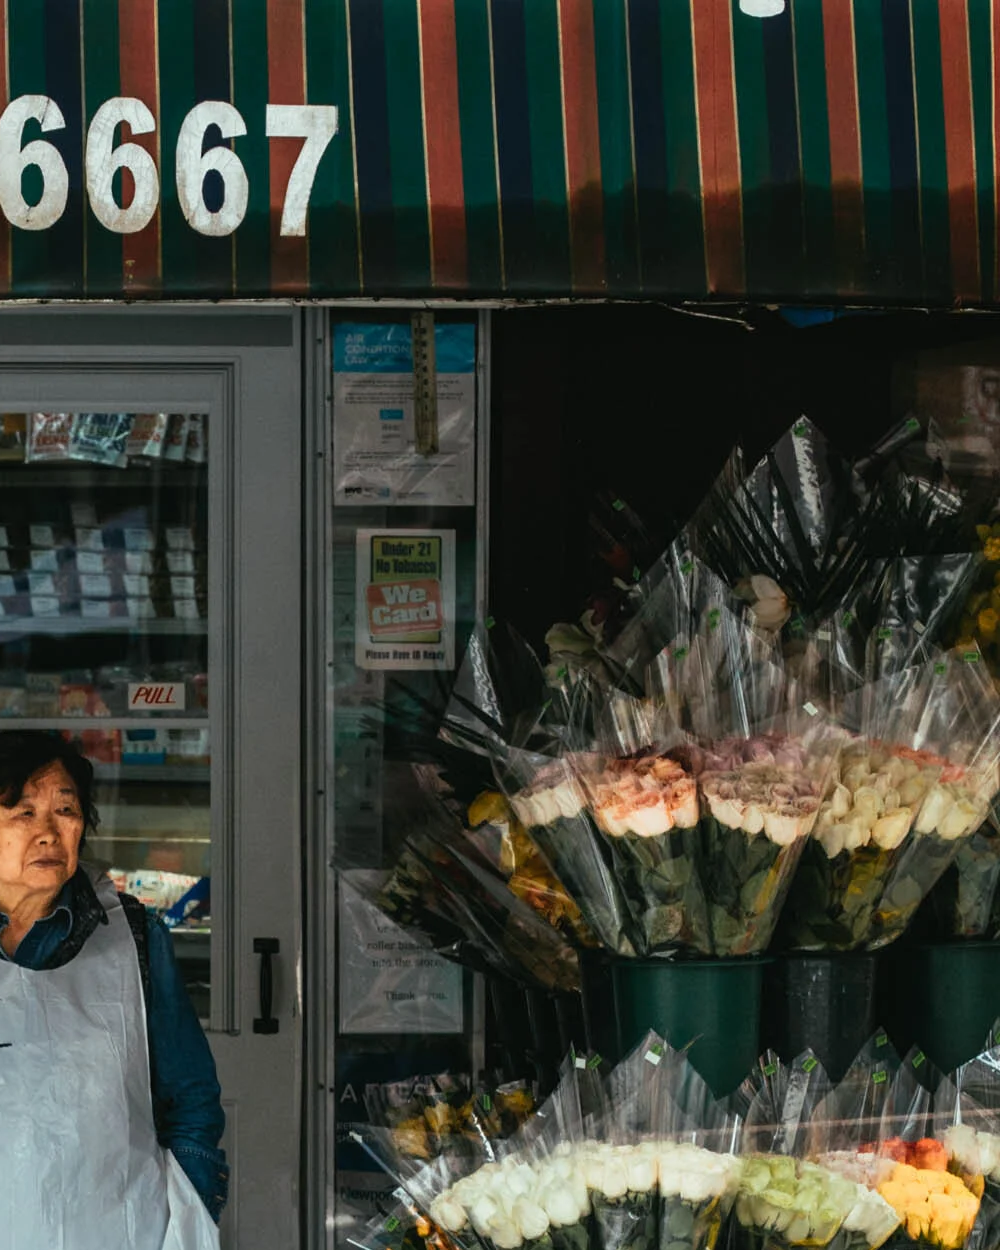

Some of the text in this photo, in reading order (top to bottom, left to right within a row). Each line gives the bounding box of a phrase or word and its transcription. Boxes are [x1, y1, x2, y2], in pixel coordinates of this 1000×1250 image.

[345, 333, 364, 344] AIR
[381, 541, 432, 556] Under 21
[376, 558, 437, 573] No Tobacco
[381, 584, 426, 606] We
[372, 601, 438, 626] Card
[366, 649, 389, 660] Please
[392, 649, 409, 660] Have
[423, 649, 445, 662] Ready
[131, 686, 176, 704] PULL
[383, 990, 414, 1001] Thank
